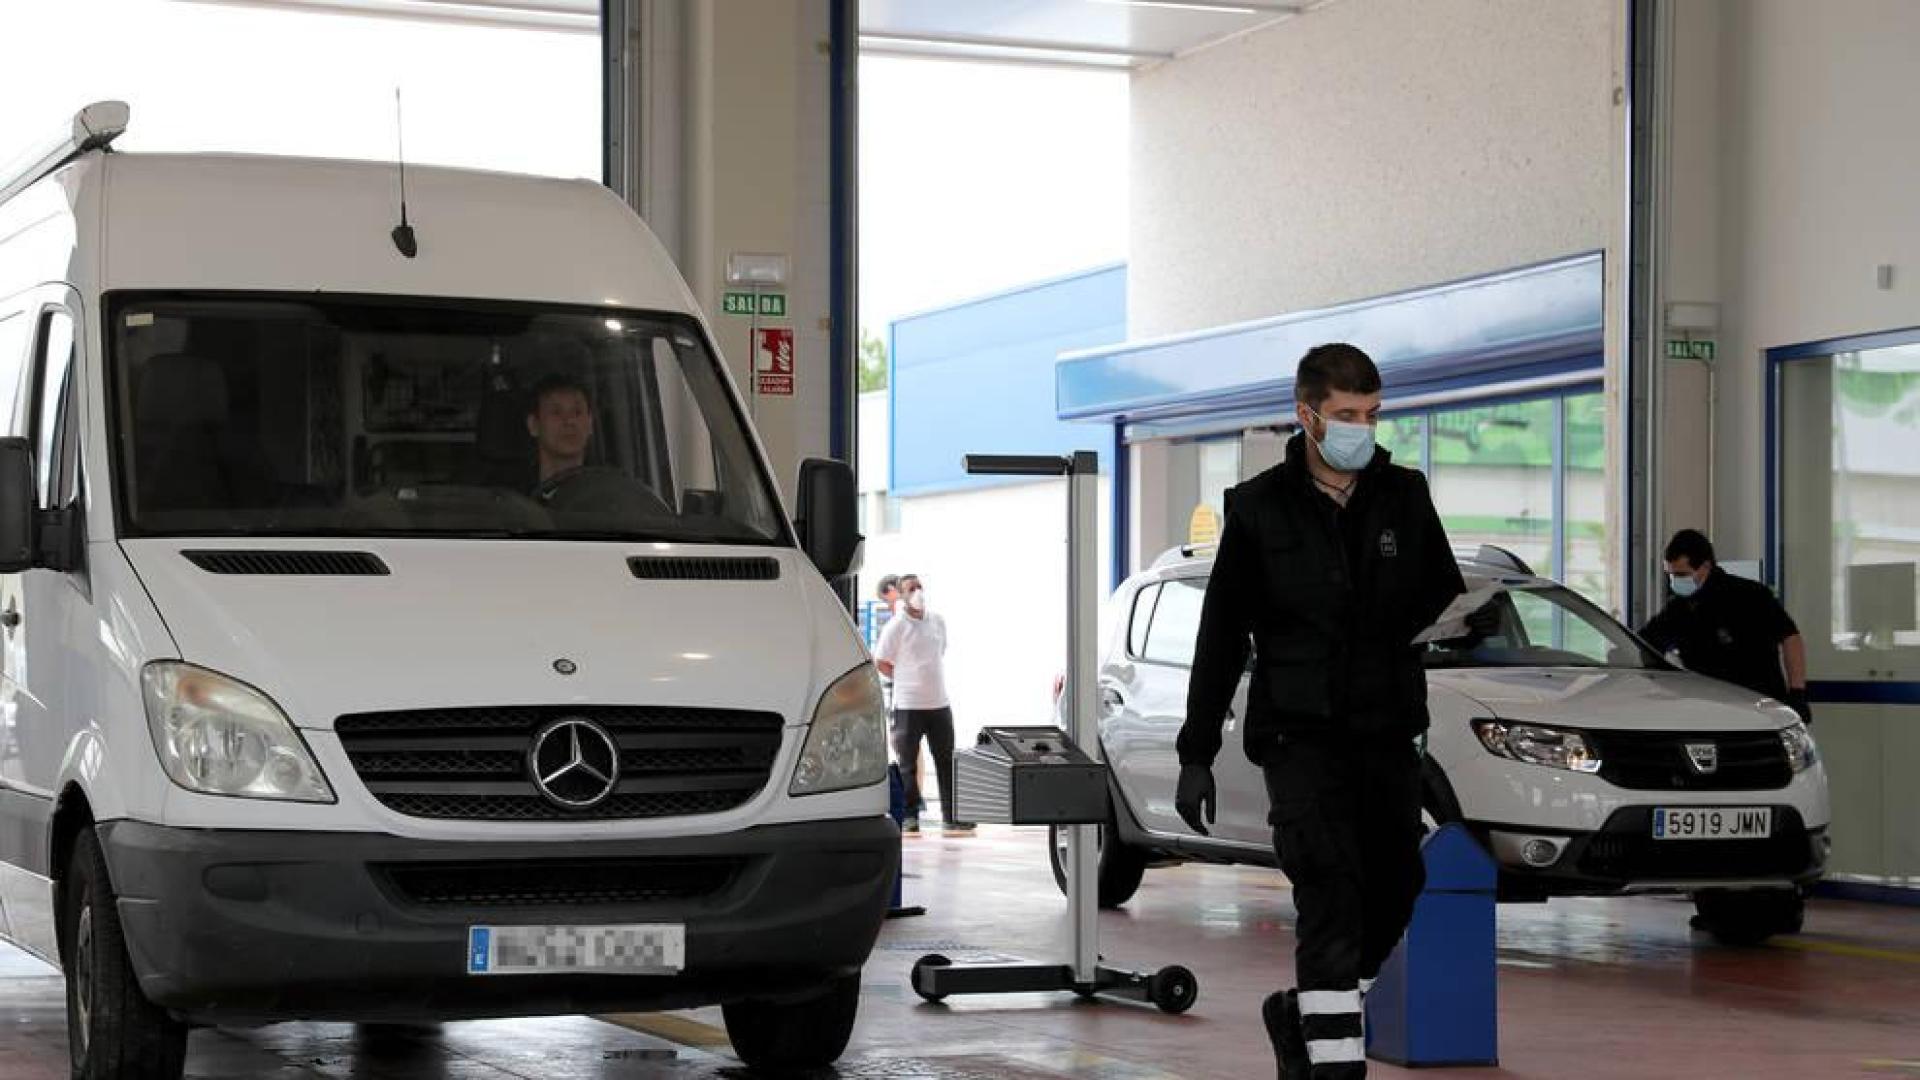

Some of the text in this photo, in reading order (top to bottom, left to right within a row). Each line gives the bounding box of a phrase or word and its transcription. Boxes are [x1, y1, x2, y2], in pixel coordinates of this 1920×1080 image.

[727, 295, 782, 313] SALDA
[1669, 811, 1766, 835] 5919 JMN
